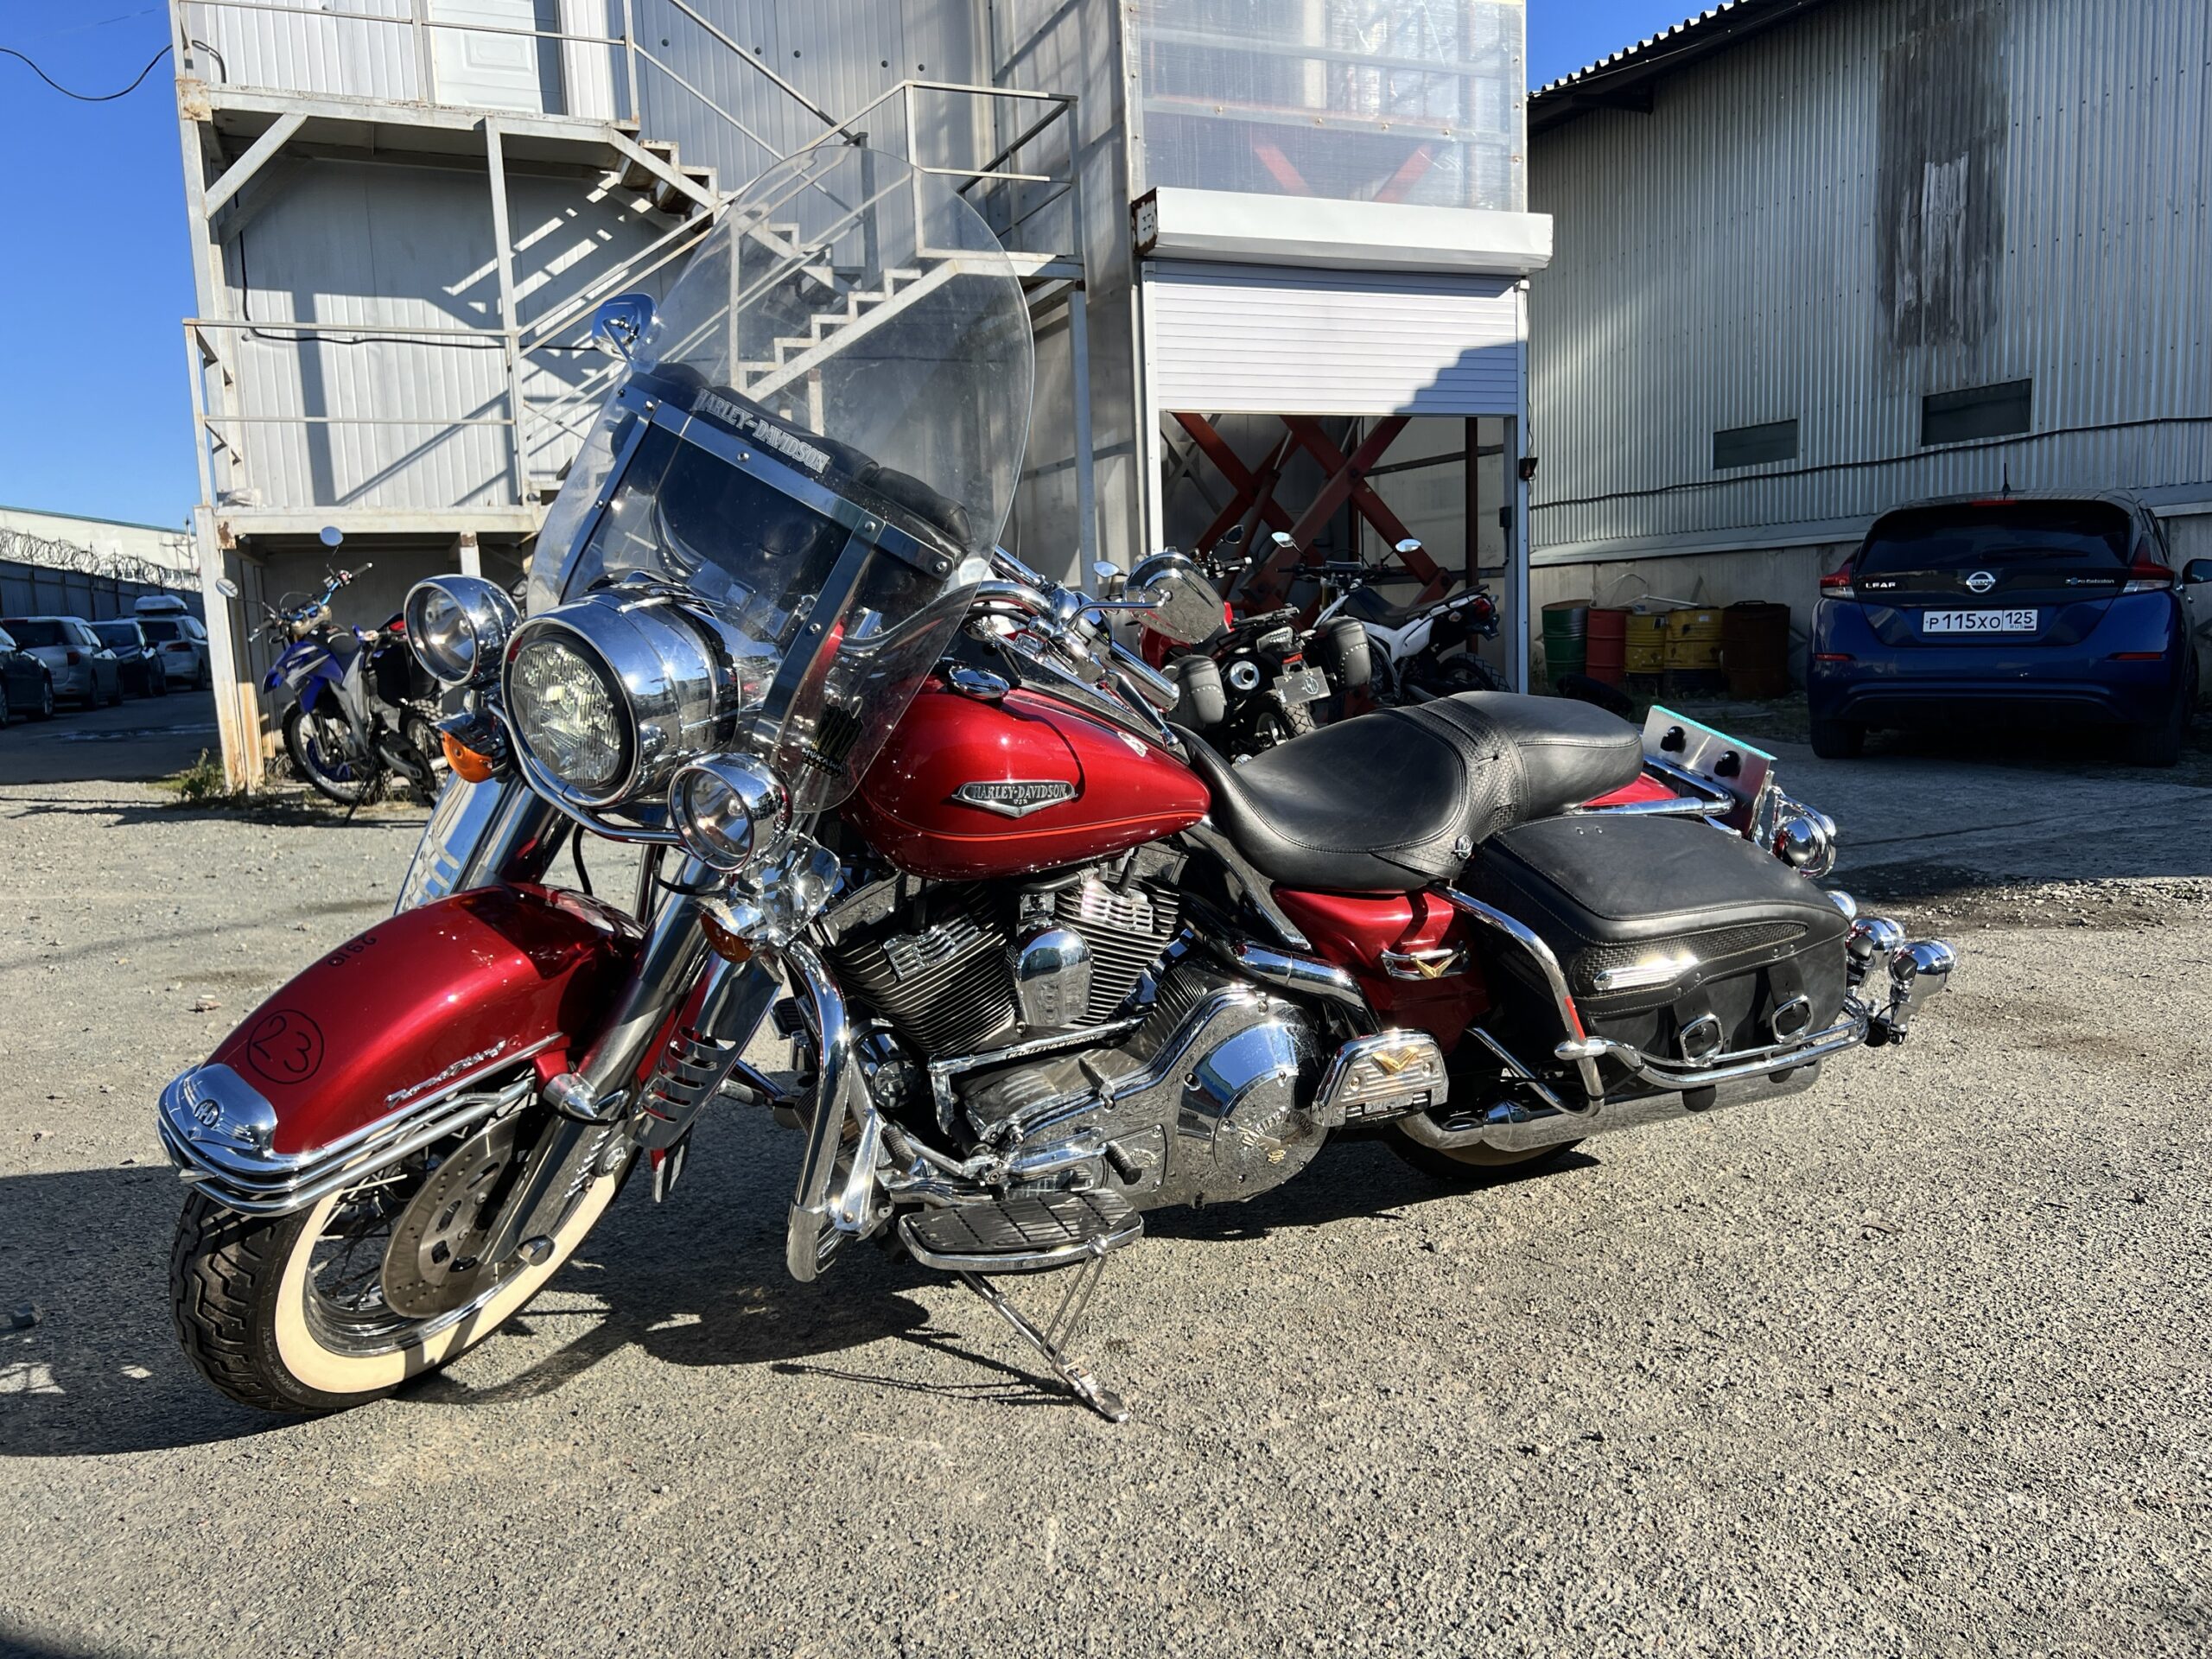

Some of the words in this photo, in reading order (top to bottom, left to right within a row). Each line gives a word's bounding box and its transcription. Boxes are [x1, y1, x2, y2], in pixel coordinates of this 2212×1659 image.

[689, 388, 830, 474] HARLEY-DAVIDSON
[2005, 612, 2032, 624] 125
[972, 784, 1068, 799] HARLEY-DAVIDSON
[252, 1015, 312, 1073] 23
